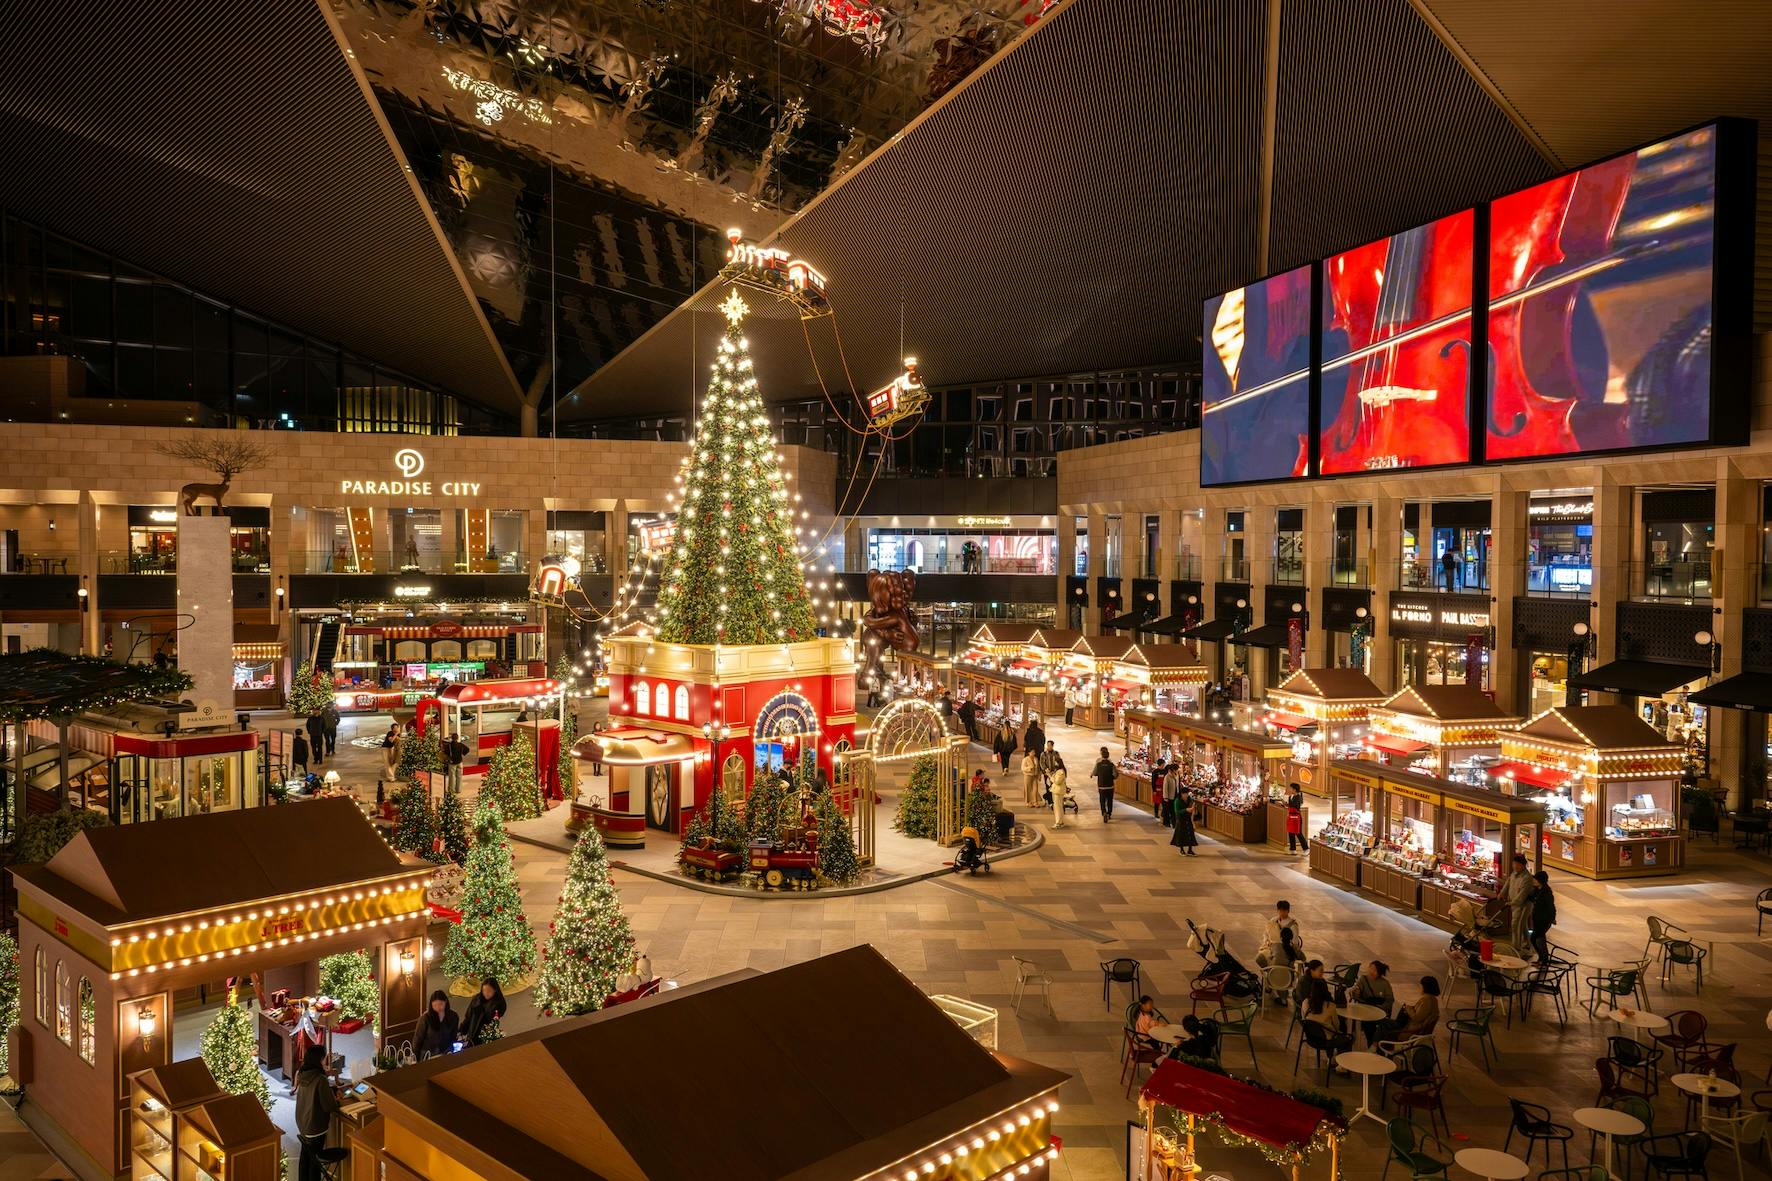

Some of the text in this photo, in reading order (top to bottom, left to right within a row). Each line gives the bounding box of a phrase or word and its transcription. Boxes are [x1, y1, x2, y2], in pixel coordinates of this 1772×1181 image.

[341, 480, 480, 496] PARADISE CITY
[1392, 610, 1401, 620] IL
[1441, 611, 1490, 627] PAUL BASST
[1414, 790, 1431, 800] MARKET
[1455, 802, 1498, 818] CHRISTMAS MARKET
[274, 919, 304, 934] TREE
